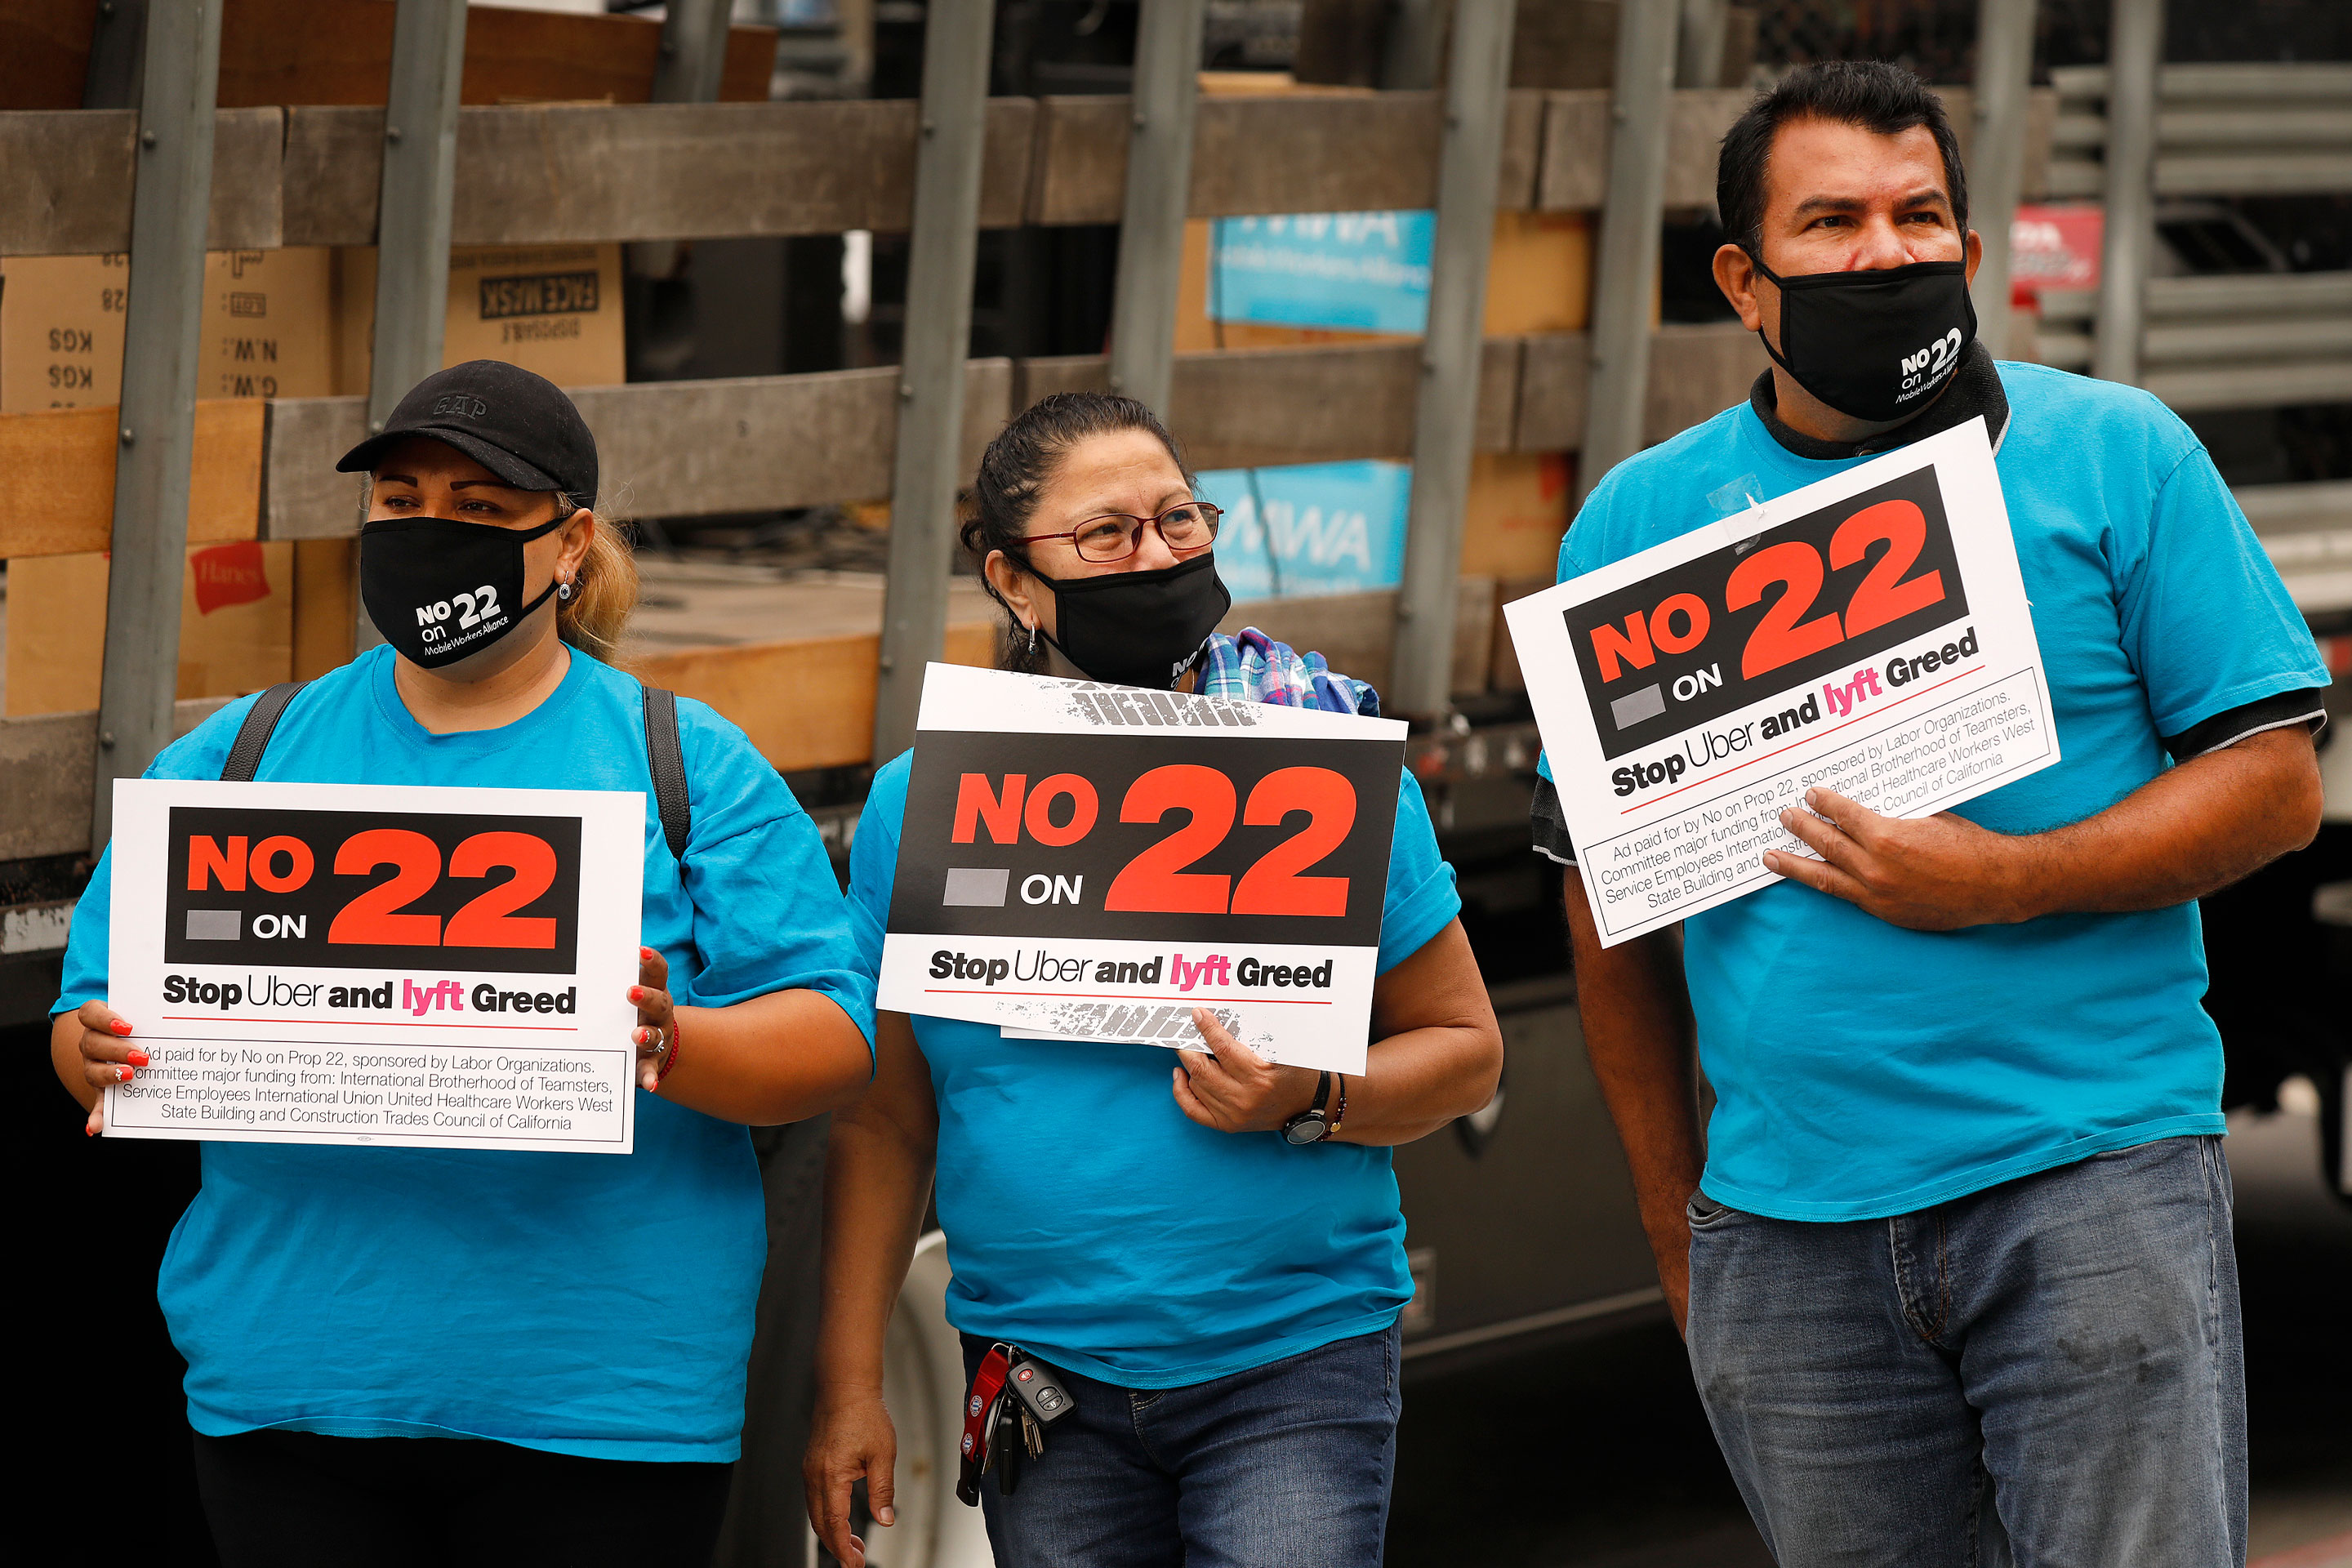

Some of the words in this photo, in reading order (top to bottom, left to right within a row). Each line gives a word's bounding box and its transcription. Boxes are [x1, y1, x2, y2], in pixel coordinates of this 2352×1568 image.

[483, 278, 543, 316] MASK
[546, 275, 597, 312] FACE
[48, 327, 92, 354] KGS
[1900, 348, 1930, 376] NO
[1931, 327, 1962, 375] 22
[48, 364, 92, 390] KGS
[1901, 373, 1922, 390] on
[433, 395, 488, 420] GAP
[416, 600, 452, 626] NO
[452, 585, 501, 630] 22
[1591, 594, 1709, 683] NO
[1726, 500, 1946, 680] 22
[421, 626, 447, 642] on
[1673, 662, 1723, 702] ON
[1612, 755, 1685, 797] Stop
[1685, 723, 1754, 768] Uber
[1761, 693, 1821, 740] and
[1823, 667, 1883, 717] lyft
[1886, 626, 1980, 688] Greed
[1601, 850, 1671, 885] Committee
[1673, 835, 1708, 859] major
[1710, 816, 1759, 844] funding
[1869, 734, 1947, 778] Brotherhood
[1949, 728, 1962, 745] of
[1963, 704, 2032, 737] Teamsters,
[1614, 842, 1633, 862] Ad
[1633, 830, 1663, 857] paid
[1664, 825, 1681, 842] for
[1683, 818, 1700, 835] by
[1702, 809, 1723, 827] No
[1725, 802, 1743, 818] on
[1743, 790, 1775, 811] Prop
[1776, 778, 1799, 797] 22,
[1801, 748, 1866, 788] sponsored
[1867, 744, 1884, 760] by
[1885, 727, 1922, 752] Labor
[1924, 692, 2011, 735] Organizations.
[1605, 878, 1653, 904] Service
[1654, 850, 1724, 885] Employees
[1882, 757, 1947, 794] Healthcare
[1948, 734, 2001, 764] Workers
[2002, 718, 2036, 742] West
[1647, 887, 1682, 908] State
[1682, 866, 1734, 895] Building
[1735, 853, 1761, 875] and
[1882, 781, 1929, 812] Council
[1931, 772, 1944, 791] of
[1946, 753, 2004, 784] California
[952, 773, 1099, 847] NO
[1104, 764, 1356, 917] 22
[187, 835, 314, 893] NO
[327, 828, 557, 949] 22
[1020, 874, 1084, 905] ON
[252, 914, 307, 939] ON
[929, 950, 1009, 987] Stop
[1014, 950, 1093, 982] Uber
[1095, 956, 1163, 984] and
[1170, 954, 1231, 991] lyft
[1236, 958, 1334, 988] Greed
[163, 974, 243, 1011] Stop
[247, 975, 324, 1007] Uber
[327, 982, 394, 1009] and
[403, 979, 465, 1017] lyft
[472, 984, 577, 1014] Greed
[134, 1066, 198, 1080] ommittee
[202, 1068, 242, 1085] major
[244, 1067, 296, 1088] funding
[300, 1069, 336, 1085] from:
[341, 1071, 425, 1088] International
[429, 1073, 516, 1091] Brotherhood
[520, 1076, 535, 1091] of
[537, 1076, 612, 1095] Teamsters,
[144, 1046, 161, 1061] Ad
[165, 1046, 194, 1066] paid
[198, 1047, 217, 1063] for
[220, 1048, 238, 1067] by
[242, 1049, 263, 1065] No
[265, 1053, 284, 1065] on
[288, 1049, 322, 1070] Prop
[325, 1051, 348, 1070] 22,
[352, 1054, 426, 1074] sponsored
[430, 1054, 448, 1073] by
[452, 1054, 493, 1071] Labor
[497, 1056, 595, 1076] Organizations.
[122, 1084, 172, 1099] Service
[176, 1085, 251, 1104] Employees
[255, 1087, 340, 1105] International
[343, 1089, 384, 1107] Union
[388, 1091, 433, 1107] United
[437, 1093, 512, 1110] Healthcare
[515, 1094, 574, 1111] Workers
[577, 1097, 613, 1113] West
[160, 1103, 197, 1120] State
[201, 1105, 256, 1125] Building
[259, 1107, 287, 1122] and
[290, 1107, 378, 1125] Construction
[382, 1110, 430, 1127] Trades
[433, 1111, 486, 1129] Council
[489, 1113, 504, 1129] of
[507, 1113, 572, 1130] California
